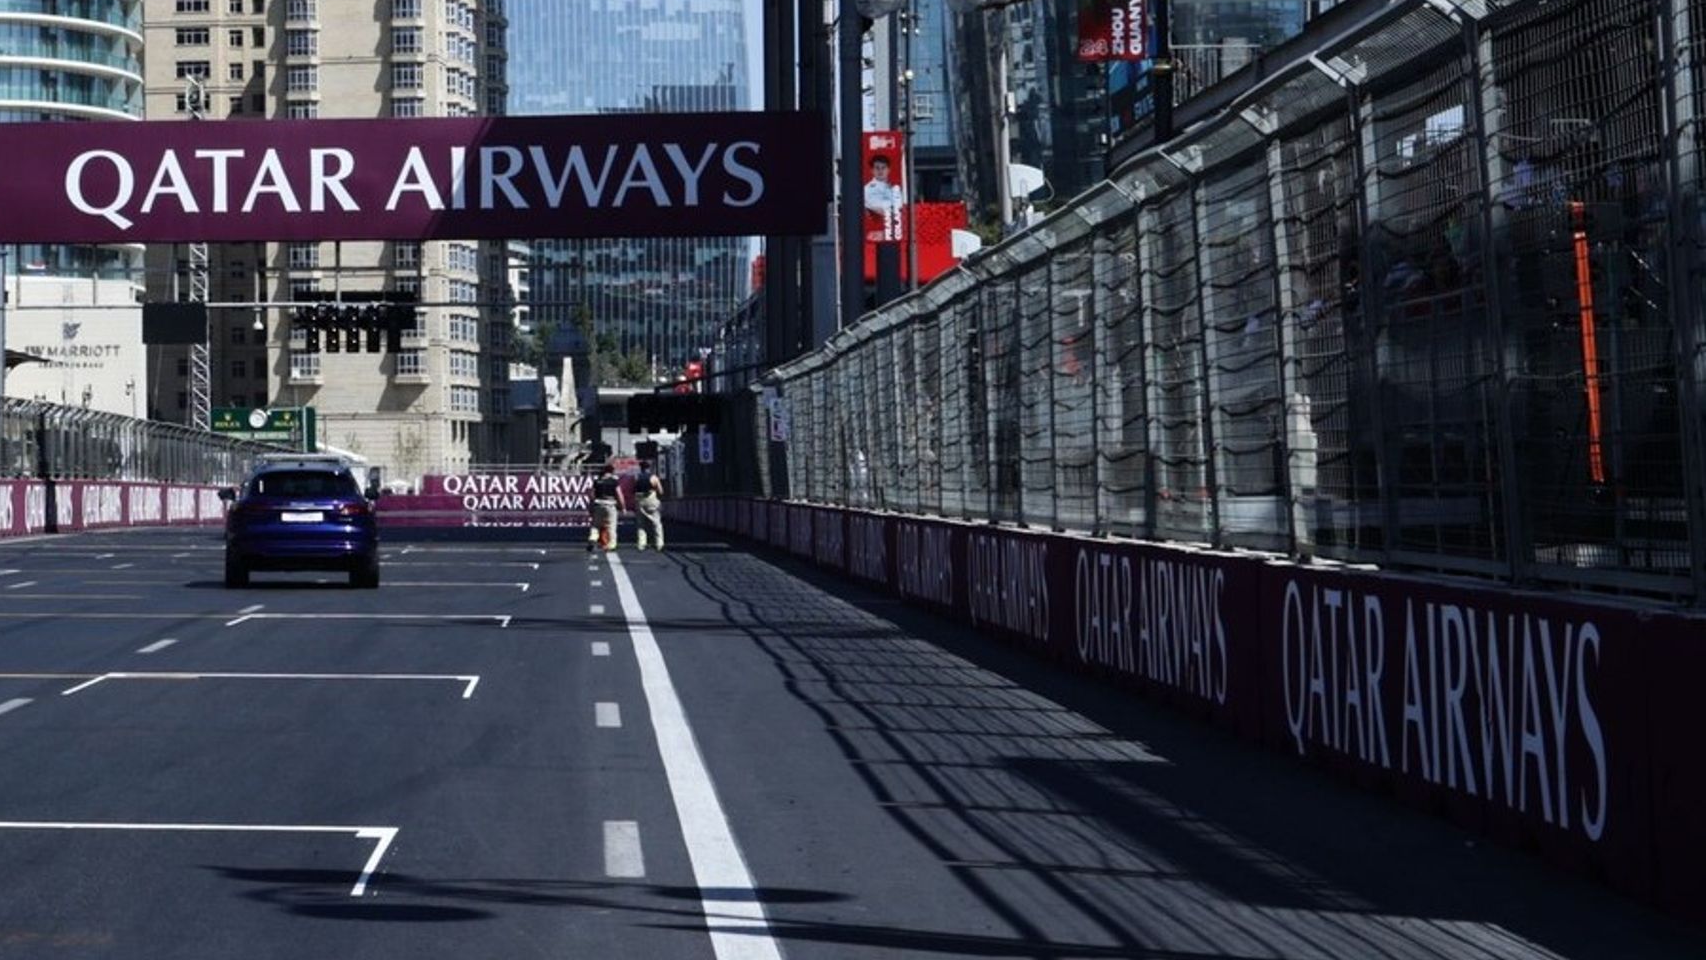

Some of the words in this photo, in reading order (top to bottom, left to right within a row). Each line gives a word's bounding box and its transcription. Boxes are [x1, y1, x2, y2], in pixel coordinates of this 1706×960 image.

[1111, 8, 1125, 55] ZHOU
[65, 148, 359, 229] QATAR
[385, 141, 764, 211] AIRWAYS
[47, 344, 121, 357] MARRIOTT
[444, 475, 519, 494] QATAR
[525, 474, 596, 493] AIRWA
[464, 494, 524, 510] QATAR
[528, 494, 590, 510] AIRWA
[1076, 546, 1135, 674] QATAR
[1138, 555, 1228, 707] AIRWAYS
[1282, 578, 1392, 770] QATAR
[1401, 595, 1608, 842] AIRWAYS
